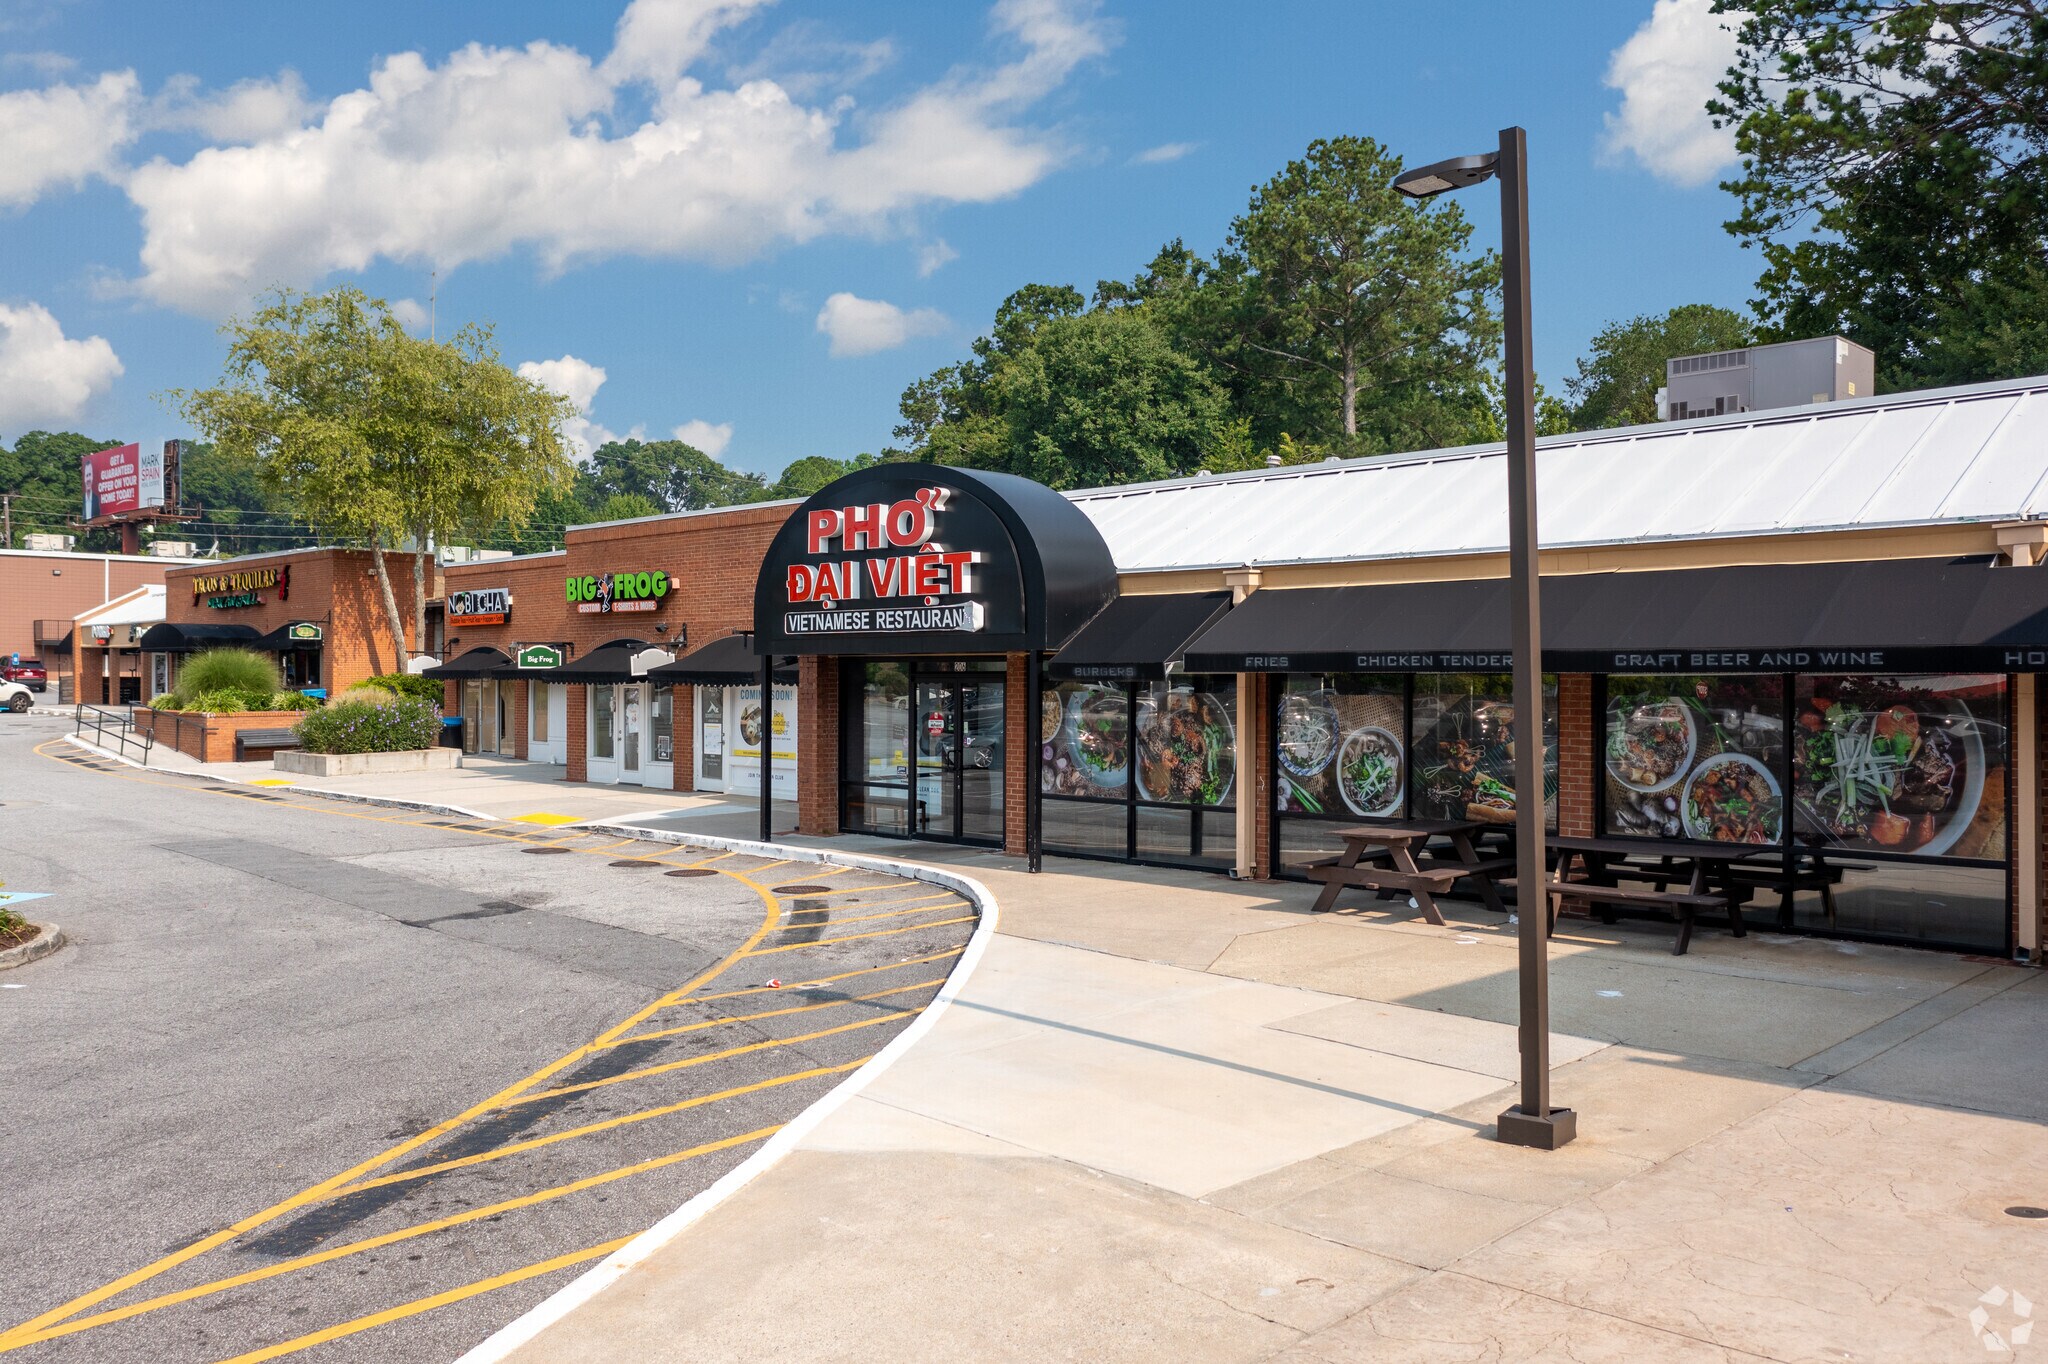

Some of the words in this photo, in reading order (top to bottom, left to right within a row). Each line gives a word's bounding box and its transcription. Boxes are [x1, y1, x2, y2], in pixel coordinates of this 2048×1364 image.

[109, 454, 120, 466] GET
[120, 453, 125, 464] A
[141, 454, 160, 468] MARK
[100, 464, 134, 480] GUARANTEED
[141, 467, 160, 481] SPAIN
[98, 480, 114, 493] OFFER
[114, 477, 122, 489] ON
[123, 475, 137, 487] YOUR
[100, 492, 116, 504] HOME
[116, 488, 135, 501] TODAY!
[192, 577, 218, 594] TACOS
[219, 576, 229, 591] &
[230, 569, 276, 591] TEQUILAS
[786, 561, 860, 610] ĐẠI
[866, 542, 980, 606] VIỆT
[566, 576, 597, 602] BIG
[614, 570, 667, 599] FROG
[478, 592, 502, 612] CHA
[579, 603, 601, 613] CUSTOM
[614, 602, 635, 611] T-SHIRTS
[635, 602, 640, 611] &
[640, 601, 656, 611] MORE
[788, 611, 870, 632] VIETNAMESE
[527, 655, 539, 663] Big
[539, 655, 553, 663] Frog
[1245, 656, 1289, 667] FRIES
[1357, 655, 1434, 667] CHICKEN
[1440, 655, 1513, 667] TENDER
[1614, 654, 1682, 667] CRAFT
[1690, 653, 1750, 666] BEER
[1759, 652, 1810, 666] AND
[1819, 651, 1884, 665] WINE
[2005, 651, 2048, 665] HO
[1074, 666, 1134, 677] BURGERS
